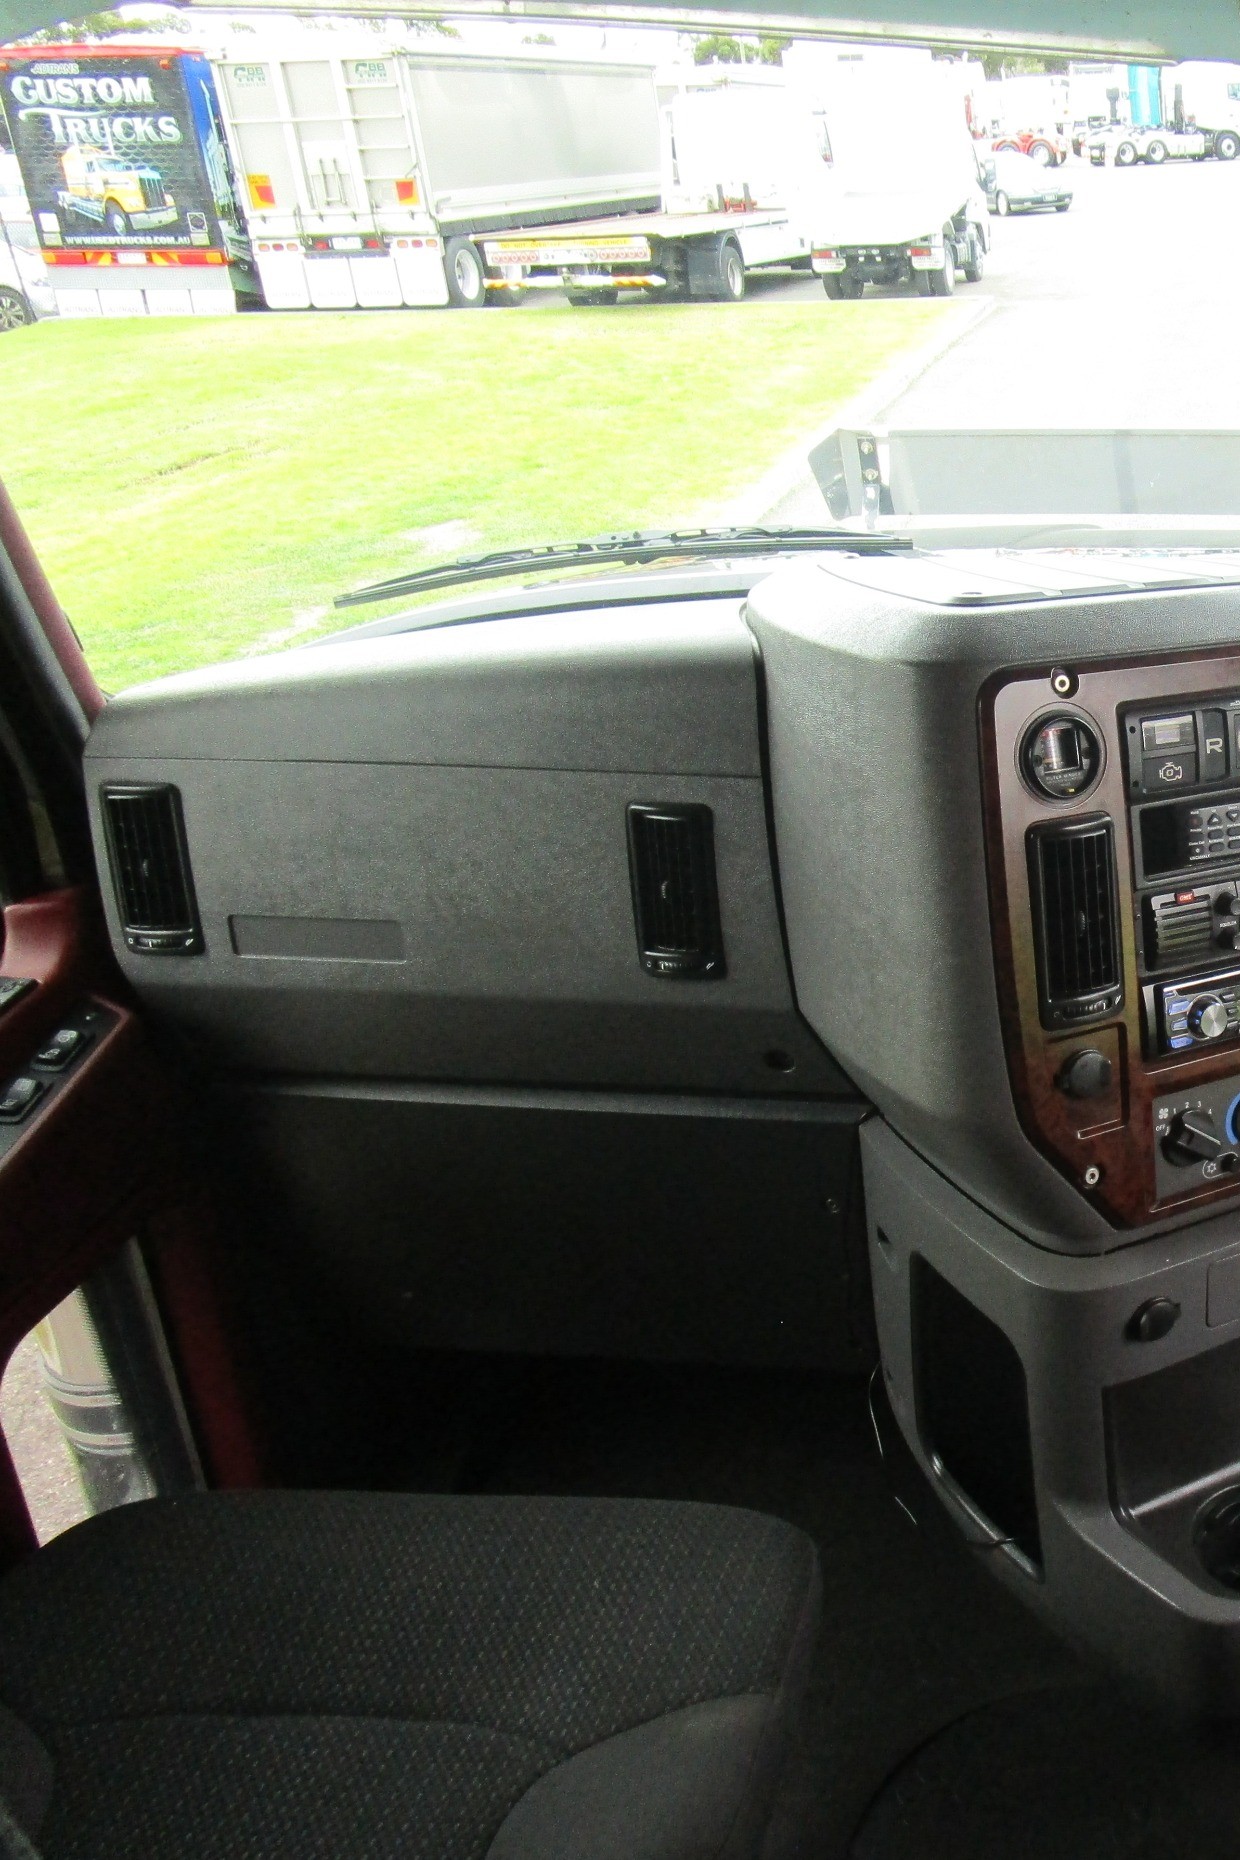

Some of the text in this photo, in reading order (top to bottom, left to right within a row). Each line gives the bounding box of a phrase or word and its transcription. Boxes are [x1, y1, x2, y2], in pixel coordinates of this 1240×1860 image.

[31, 63, 80, 75] ADTRANS
[10, 76, 155, 105] CUSTOM
[18, 107, 182, 144] TRUCKS
[64, 236, 191, 246] WWW.USEDTRUCKS.COM.AU
[1205, 737, 1224, 754] R
[1155, 1123, 1166, 1132] OFF
